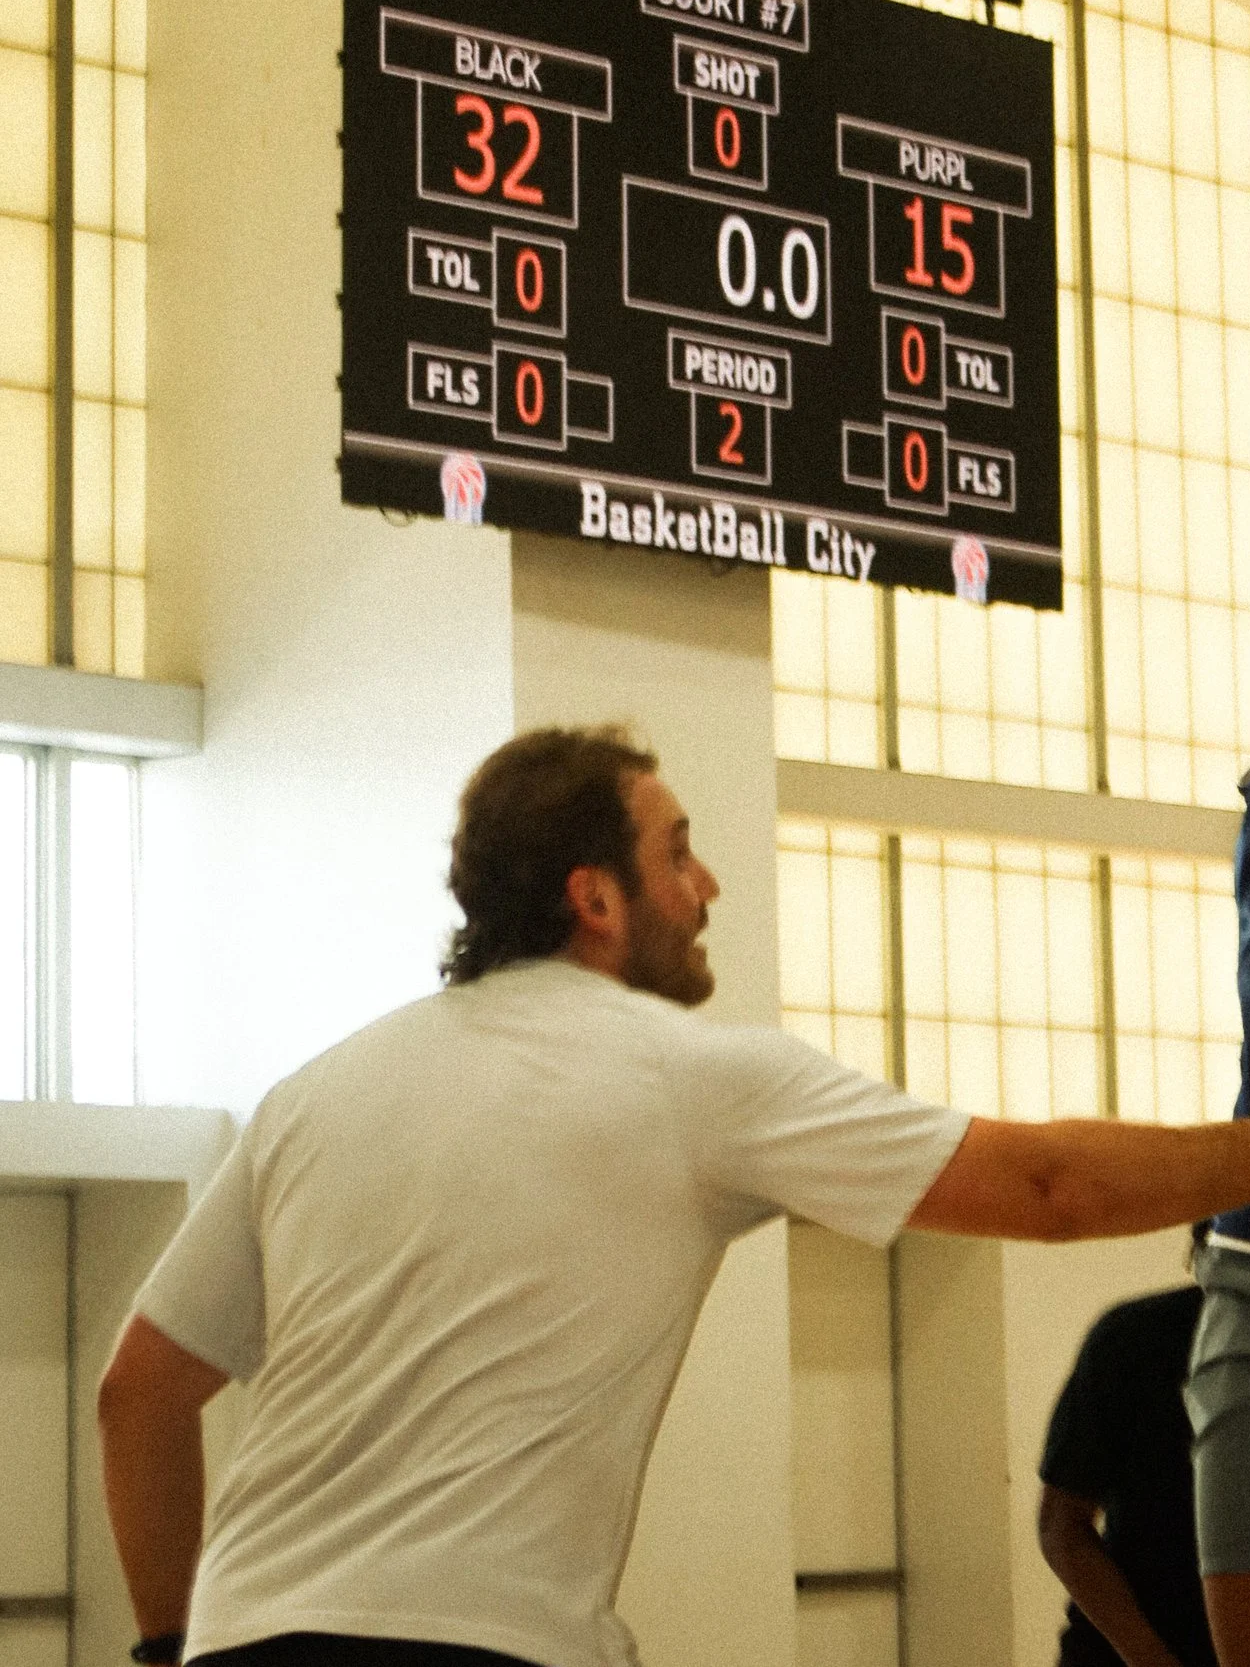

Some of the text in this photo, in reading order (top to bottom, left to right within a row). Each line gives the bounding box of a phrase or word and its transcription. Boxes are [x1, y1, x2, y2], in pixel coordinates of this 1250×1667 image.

[455, 36, 542, 91] BLACK
[693, 53, 760, 99] SHOT
[454, 94, 544, 205] 32
[714, 107, 741, 169] 0
[900, 141, 973, 192] PURPL
[718, 214, 819, 319] 0.0
[903, 195, 975, 294] 15
[426, 247, 544, 313] TOL 0
[685, 345, 776, 395] PERIOD
[901, 325, 1000, 393] 0 TOL
[426, 360, 544, 426] FLS 0
[718, 401, 744, 465] 2
[903, 430, 1001, 497] 0 FLS
[580, 481, 875, 584] BasketBall City
